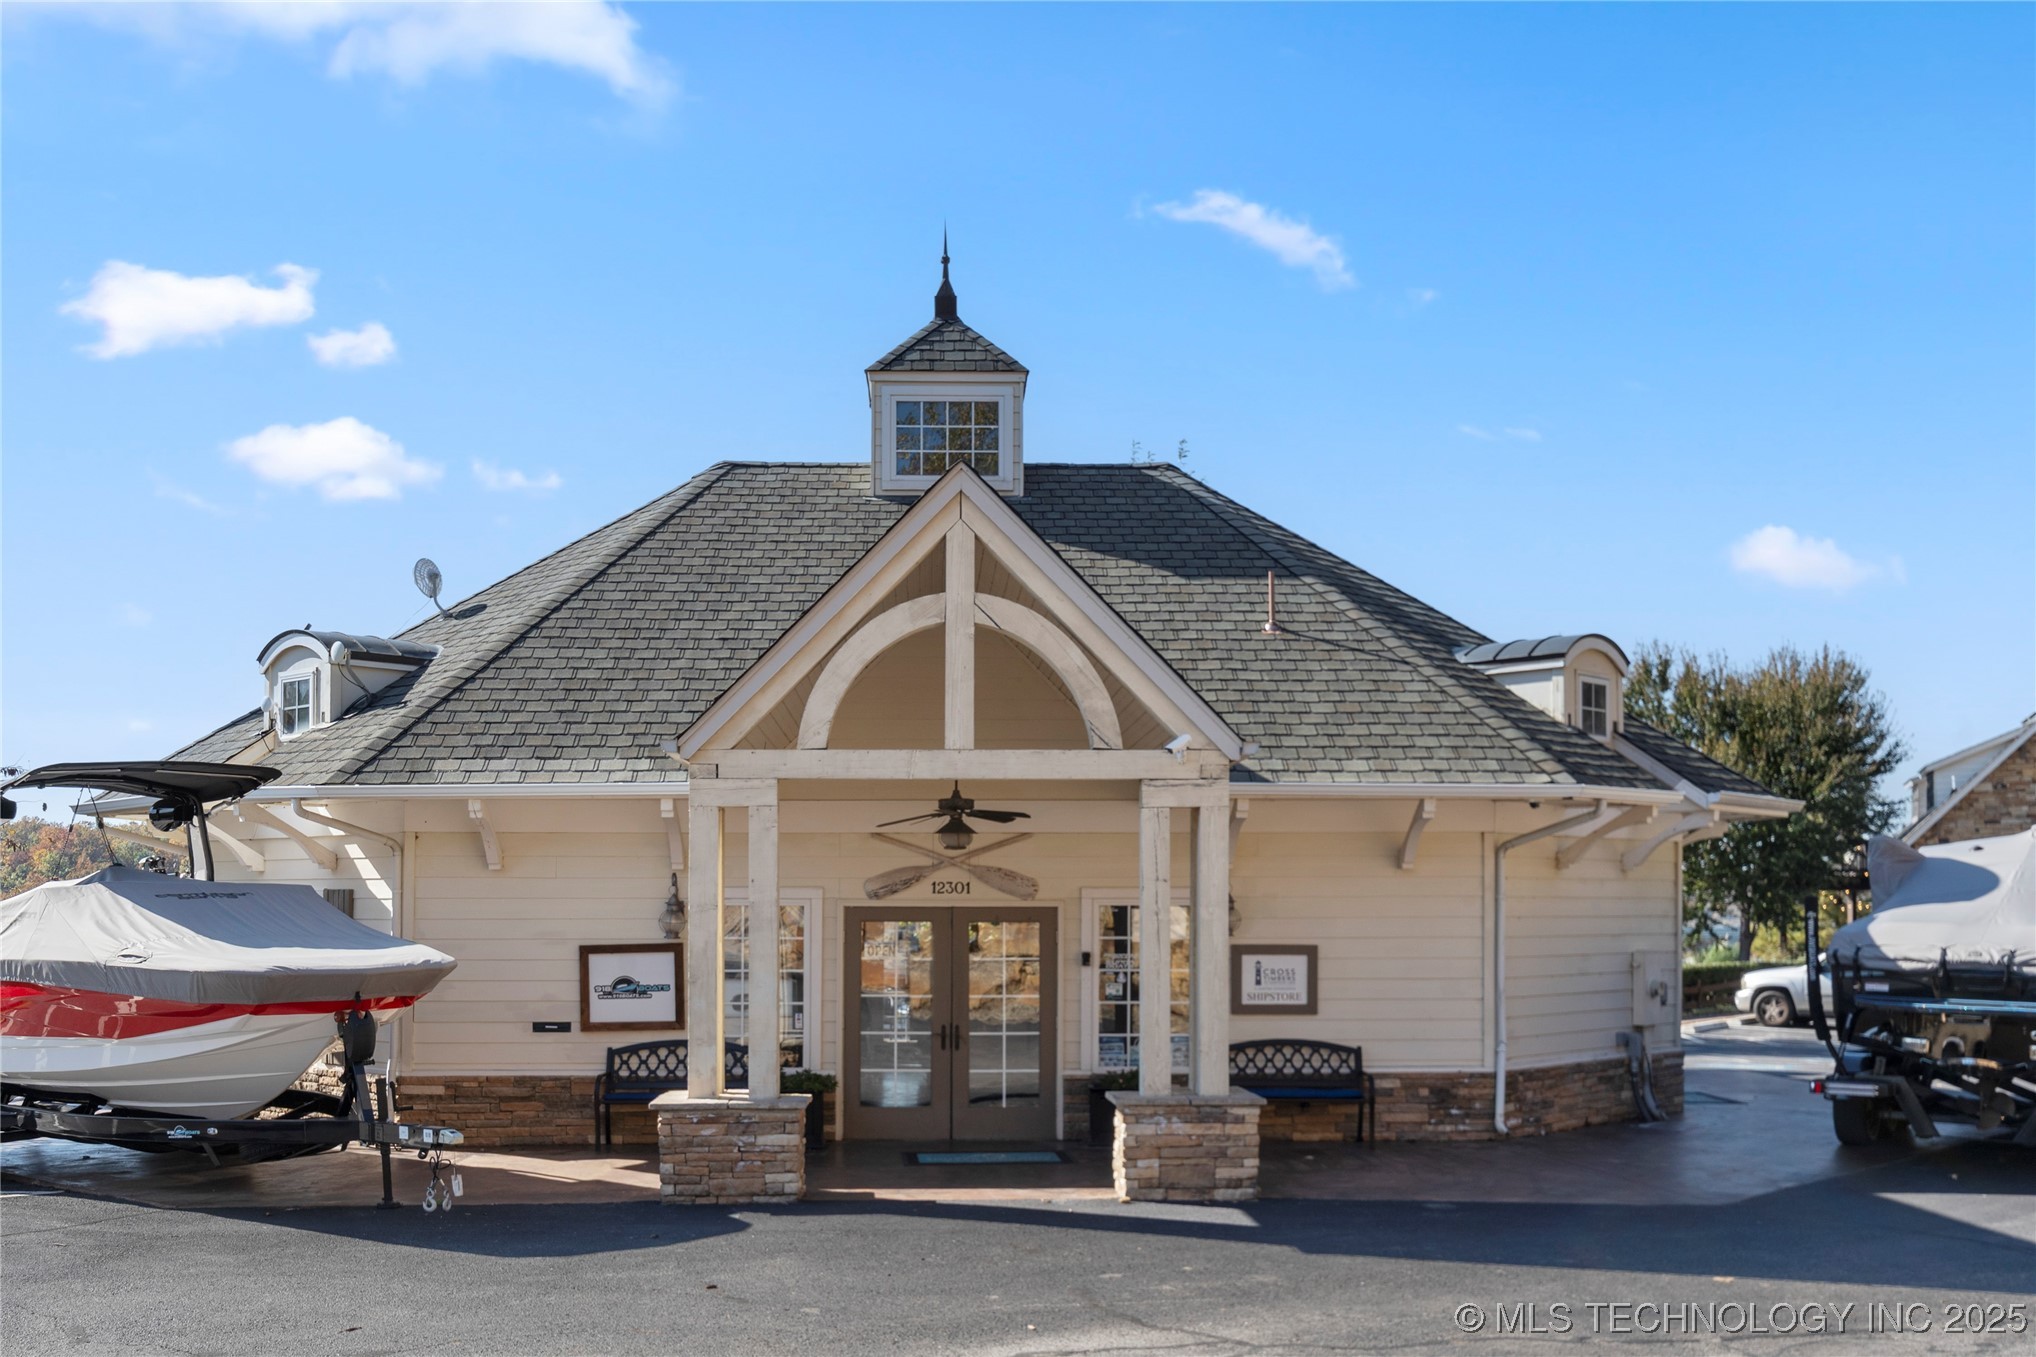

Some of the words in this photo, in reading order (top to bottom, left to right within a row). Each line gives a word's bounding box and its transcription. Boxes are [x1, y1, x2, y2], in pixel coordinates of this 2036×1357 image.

[931, 881, 970, 895] 12301
[867, 945, 895, 957] OPEN
[1263, 968, 1296, 977] CROSS
[594, 985, 611, 993] 918
[638, 984, 671, 992] BOATS
[1247, 992, 1303, 1001] SHIPSTORE
